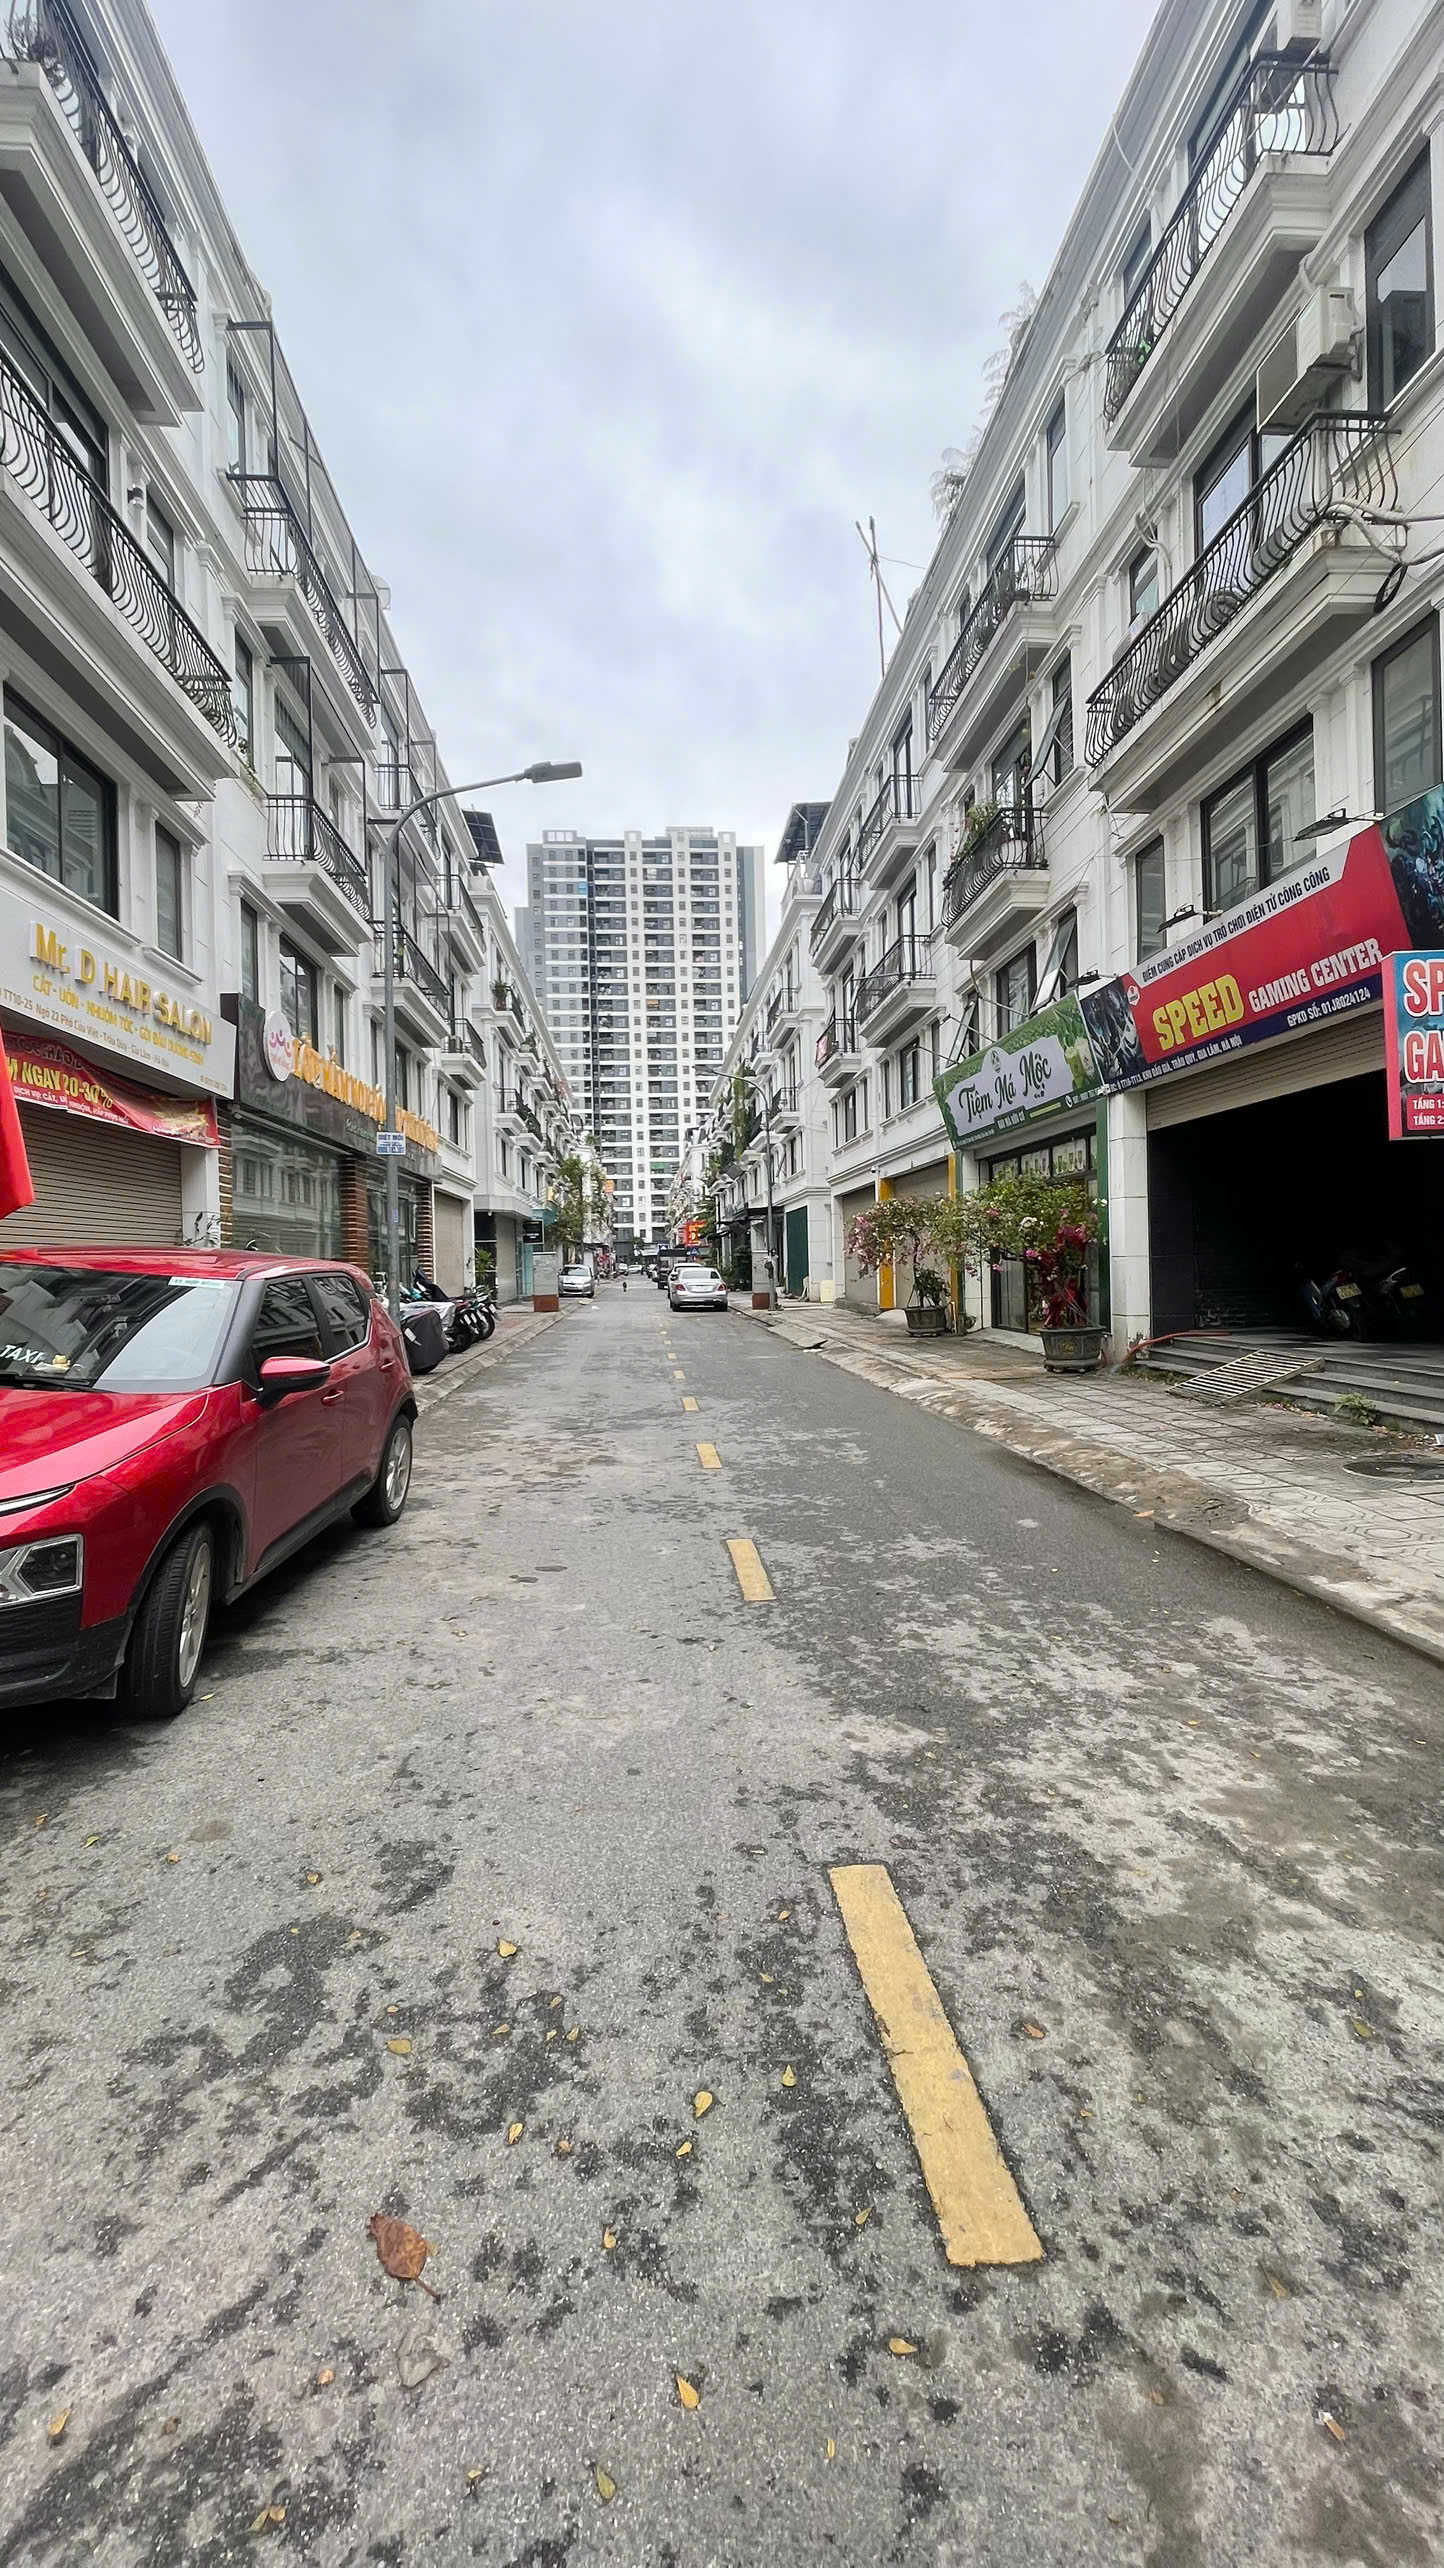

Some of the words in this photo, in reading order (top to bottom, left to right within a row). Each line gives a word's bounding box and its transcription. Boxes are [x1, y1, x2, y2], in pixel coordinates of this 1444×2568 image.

[1157, 956, 1173, 976] CUNG
[1188, 942, 1202, 959] DỊCH
[1203, 933, 1214, 951] VỤ
[1213, 922, 1228, 942] TRÒ
[1228, 913, 1247, 935] CHƠI
[1246, 903, 1266, 924] ĐIỆN
[1277, 881, 1303, 906] CÔNG
[34, 922, 71, 975] Mr.
[78, 947, 96, 985] D
[102, 960, 152, 1014] HAIR
[155, 991, 212, 1046] SALON
[1248, 968, 1312, 1014] GAMING
[1311, 937, 1383, 988] CENTER
[51, 1009, 60, 1022] 22
[1153, 974, 1245, 1051] SPEED
[1286, 1009, 1307, 1027] GPKD
[1308, 1001, 1322, 1019] SỐ:
[21, 1061, 61, 1091] NGAY
[958, 1083, 993, 1124] Tiệm
[994, 1073, 1017, 1110] Má
[1019, 1051, 1052, 1097] Mộc
[0, 1344, 44, 1365] TAXI
